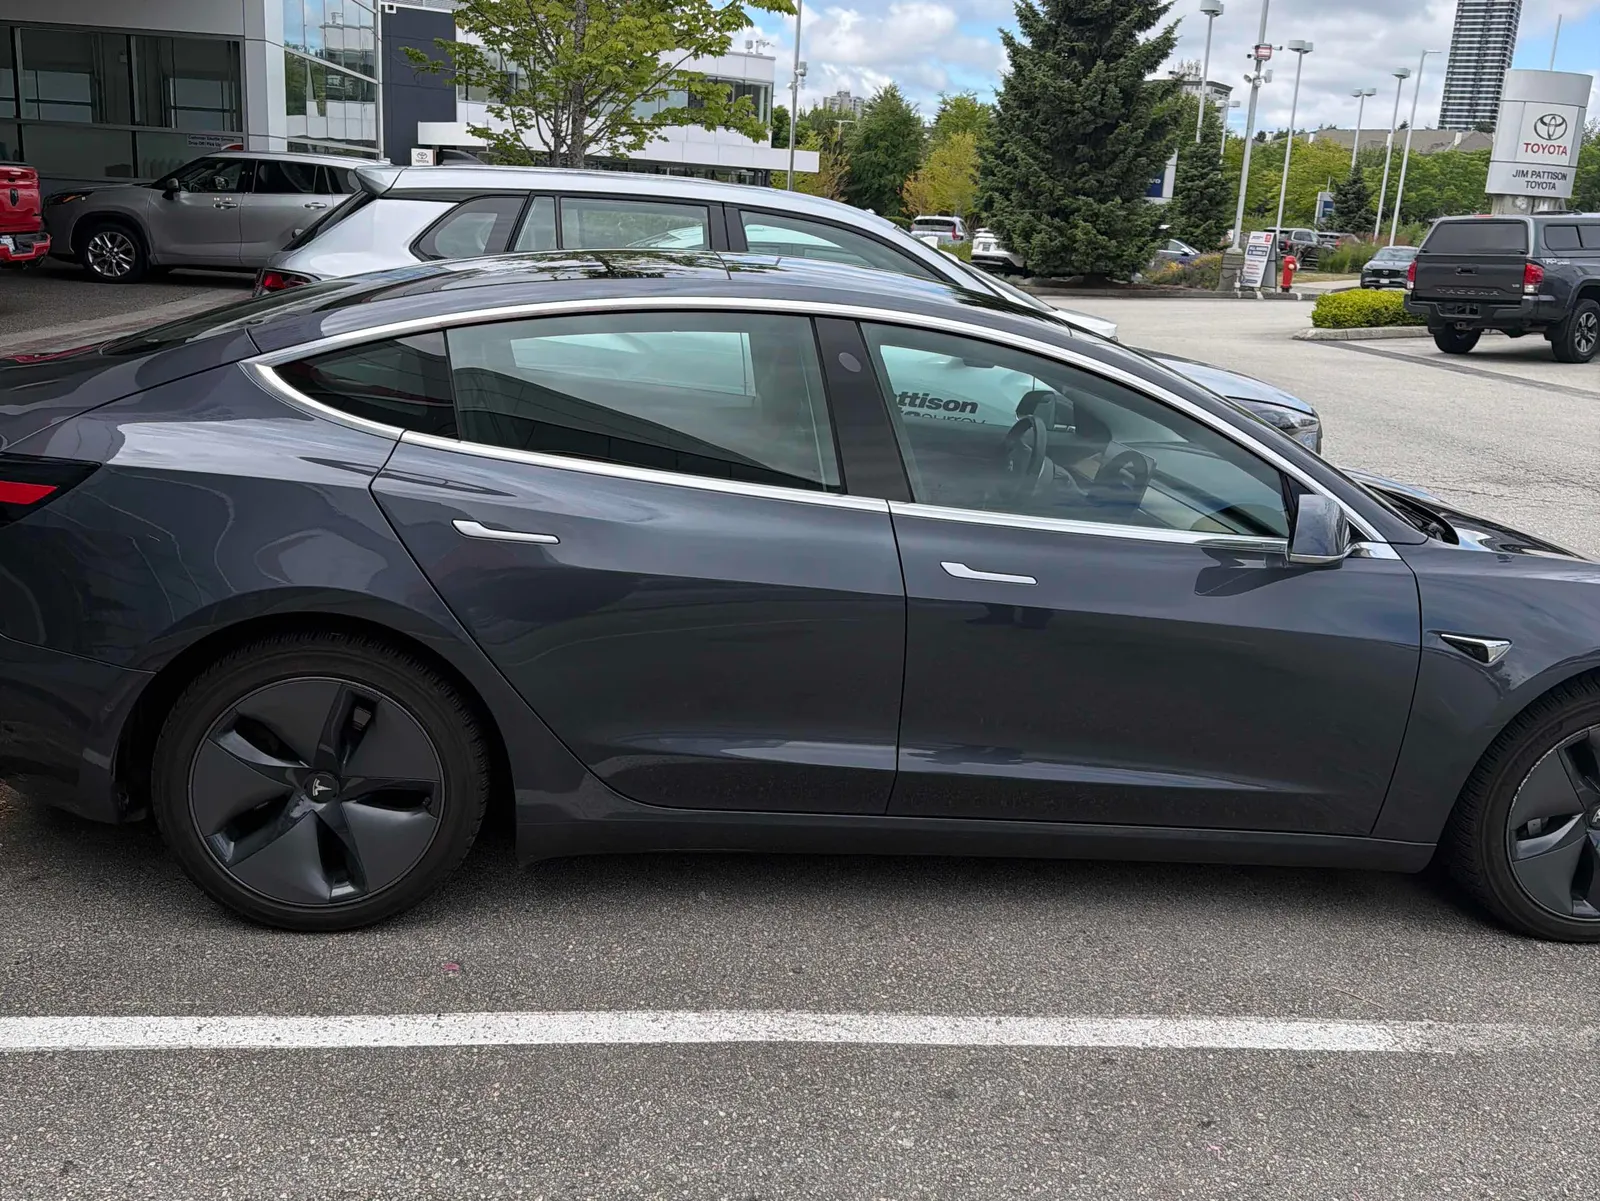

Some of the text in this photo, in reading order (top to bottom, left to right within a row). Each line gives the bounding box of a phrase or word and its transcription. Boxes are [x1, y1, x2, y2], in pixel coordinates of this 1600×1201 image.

[1523, 143, 1568, 156] TOYOTA
[1512, 169, 1568, 181] JIM PATTISON
[1525, 180, 1556, 190] TOYOTA
[896, 391, 979, 414] ttison
